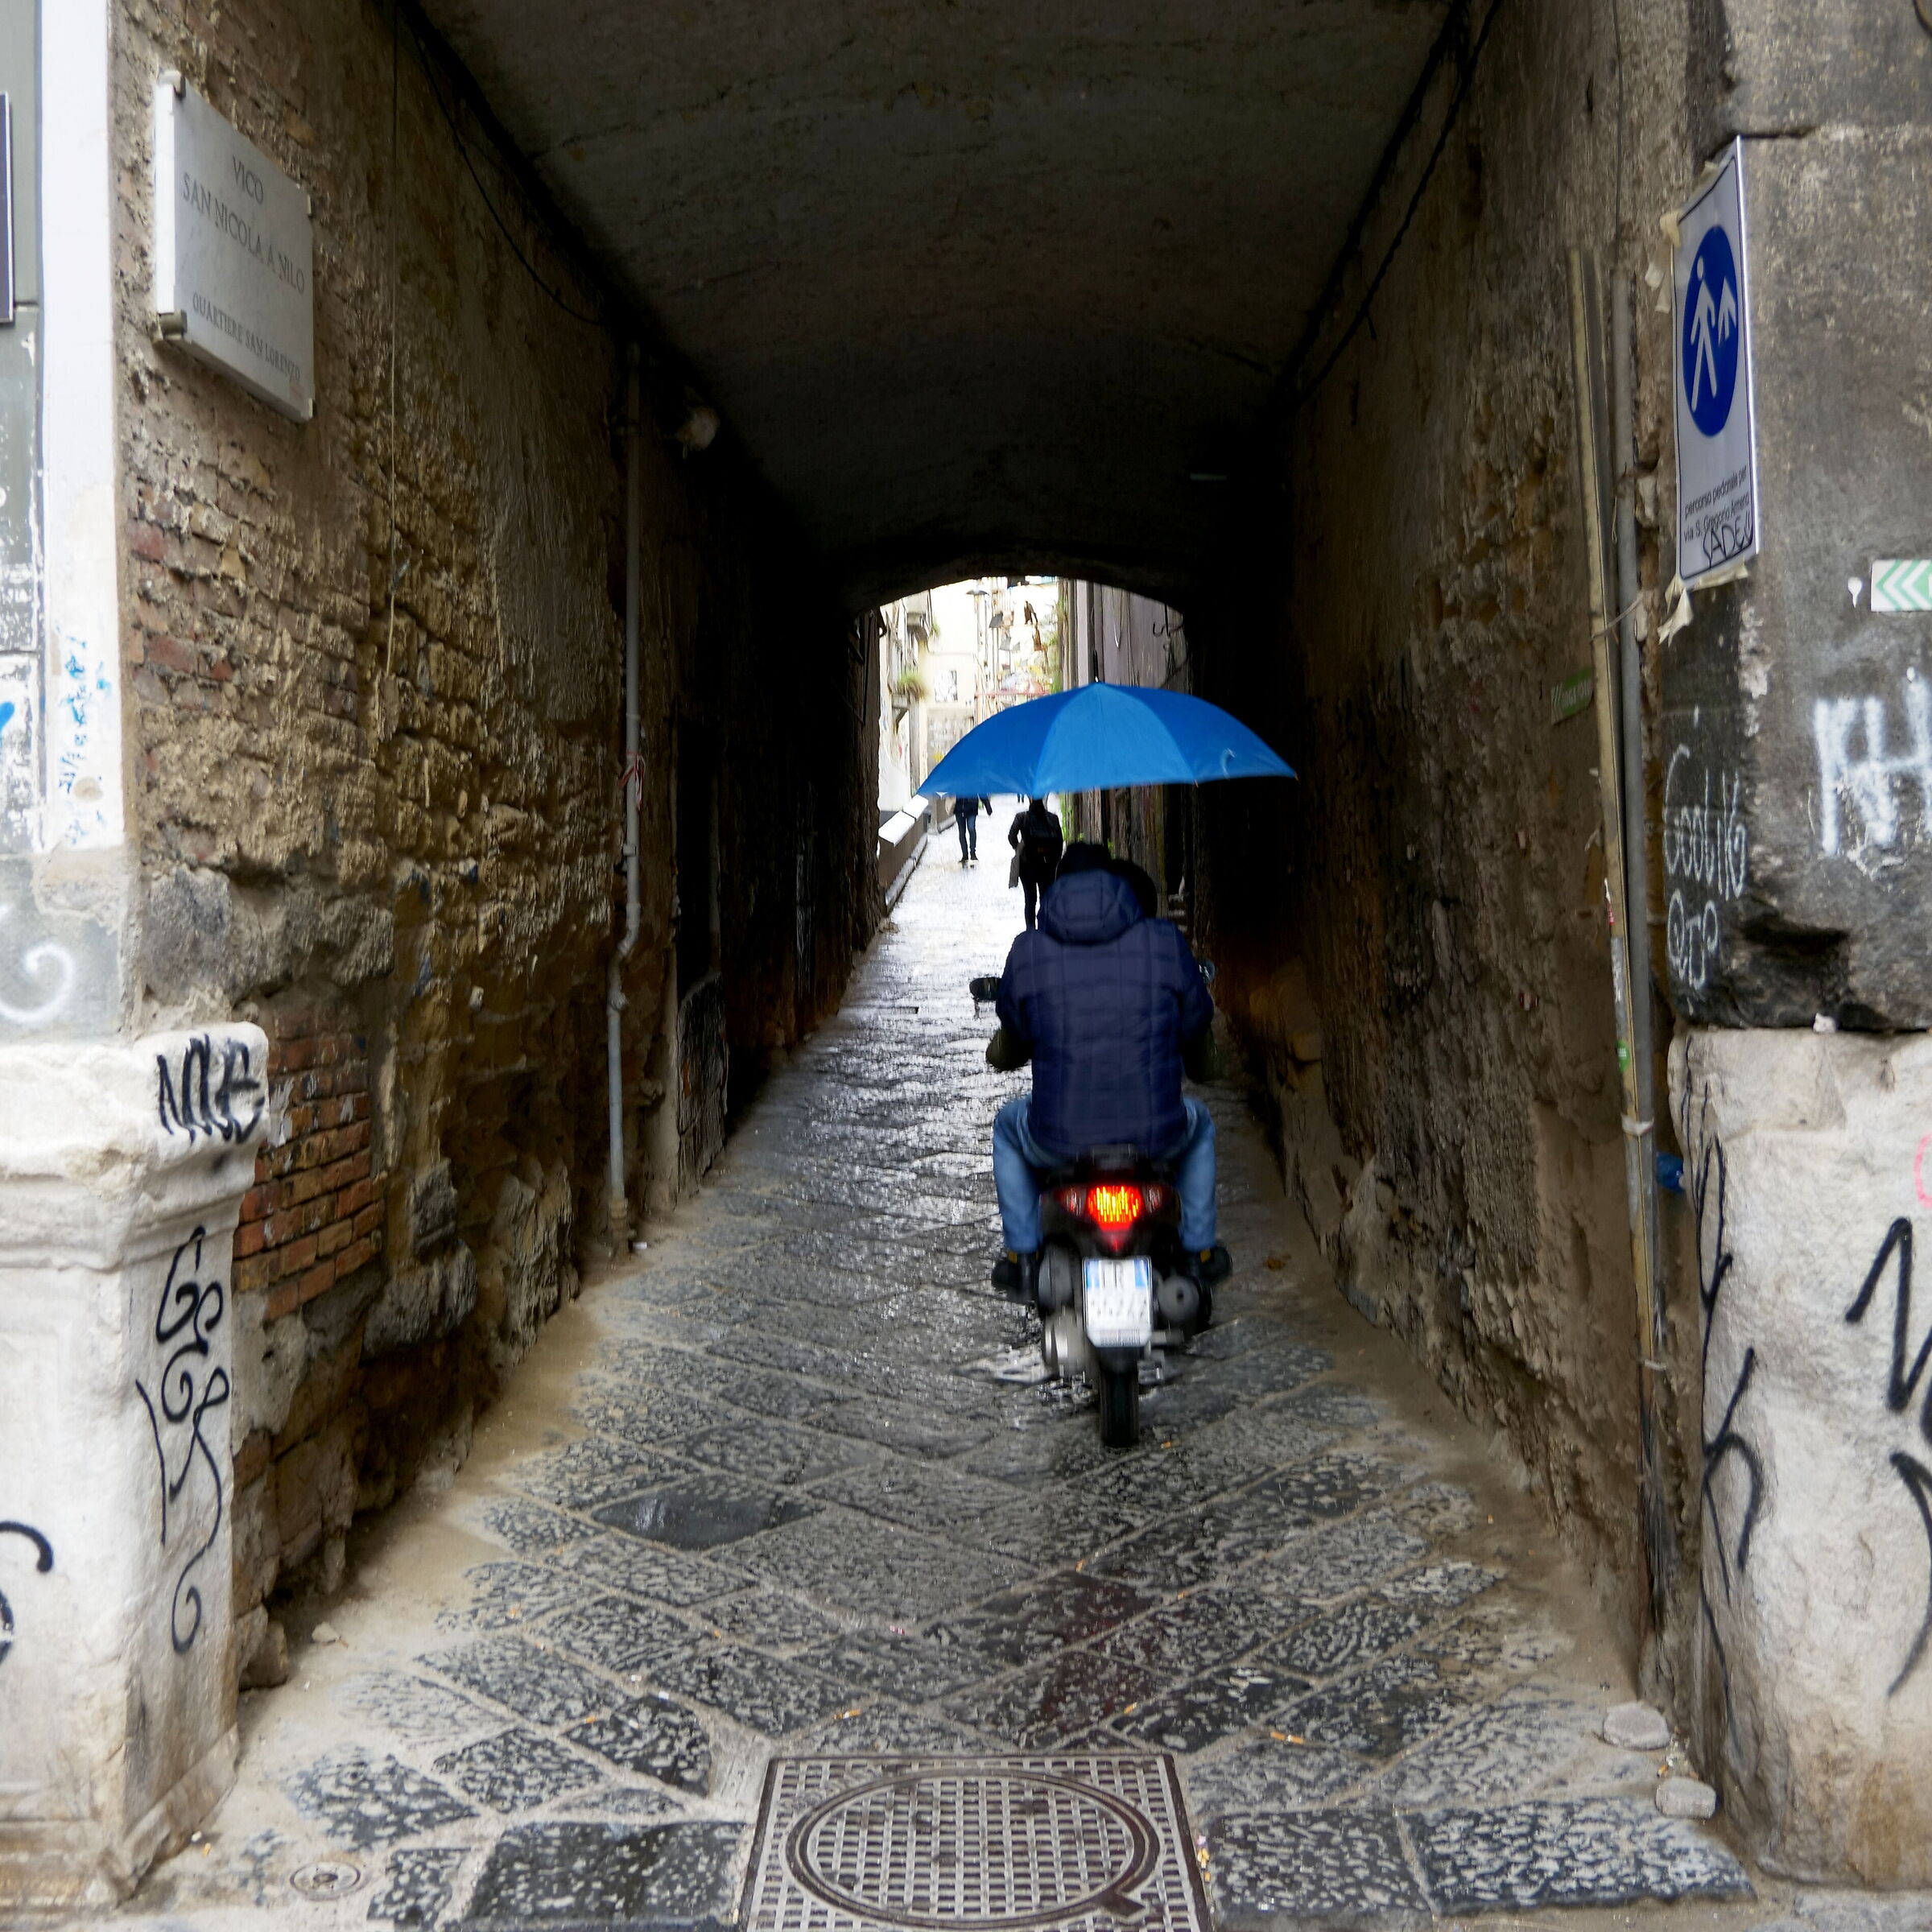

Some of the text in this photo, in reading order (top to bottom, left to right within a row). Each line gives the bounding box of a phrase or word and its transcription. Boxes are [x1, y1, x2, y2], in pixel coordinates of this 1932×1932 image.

[233, 155, 264, 204] VICO
[183, 171, 305, 295] SAN NICOLA A NILO
[193, 291, 300, 382] QUARTIERE SAN LORENZO
[1685, 493, 1711, 520] percorso
[1712, 472, 1738, 503] pedonale
[1684, 528, 1694, 544] via
[1703, 510, 1731, 533] Gregorio
